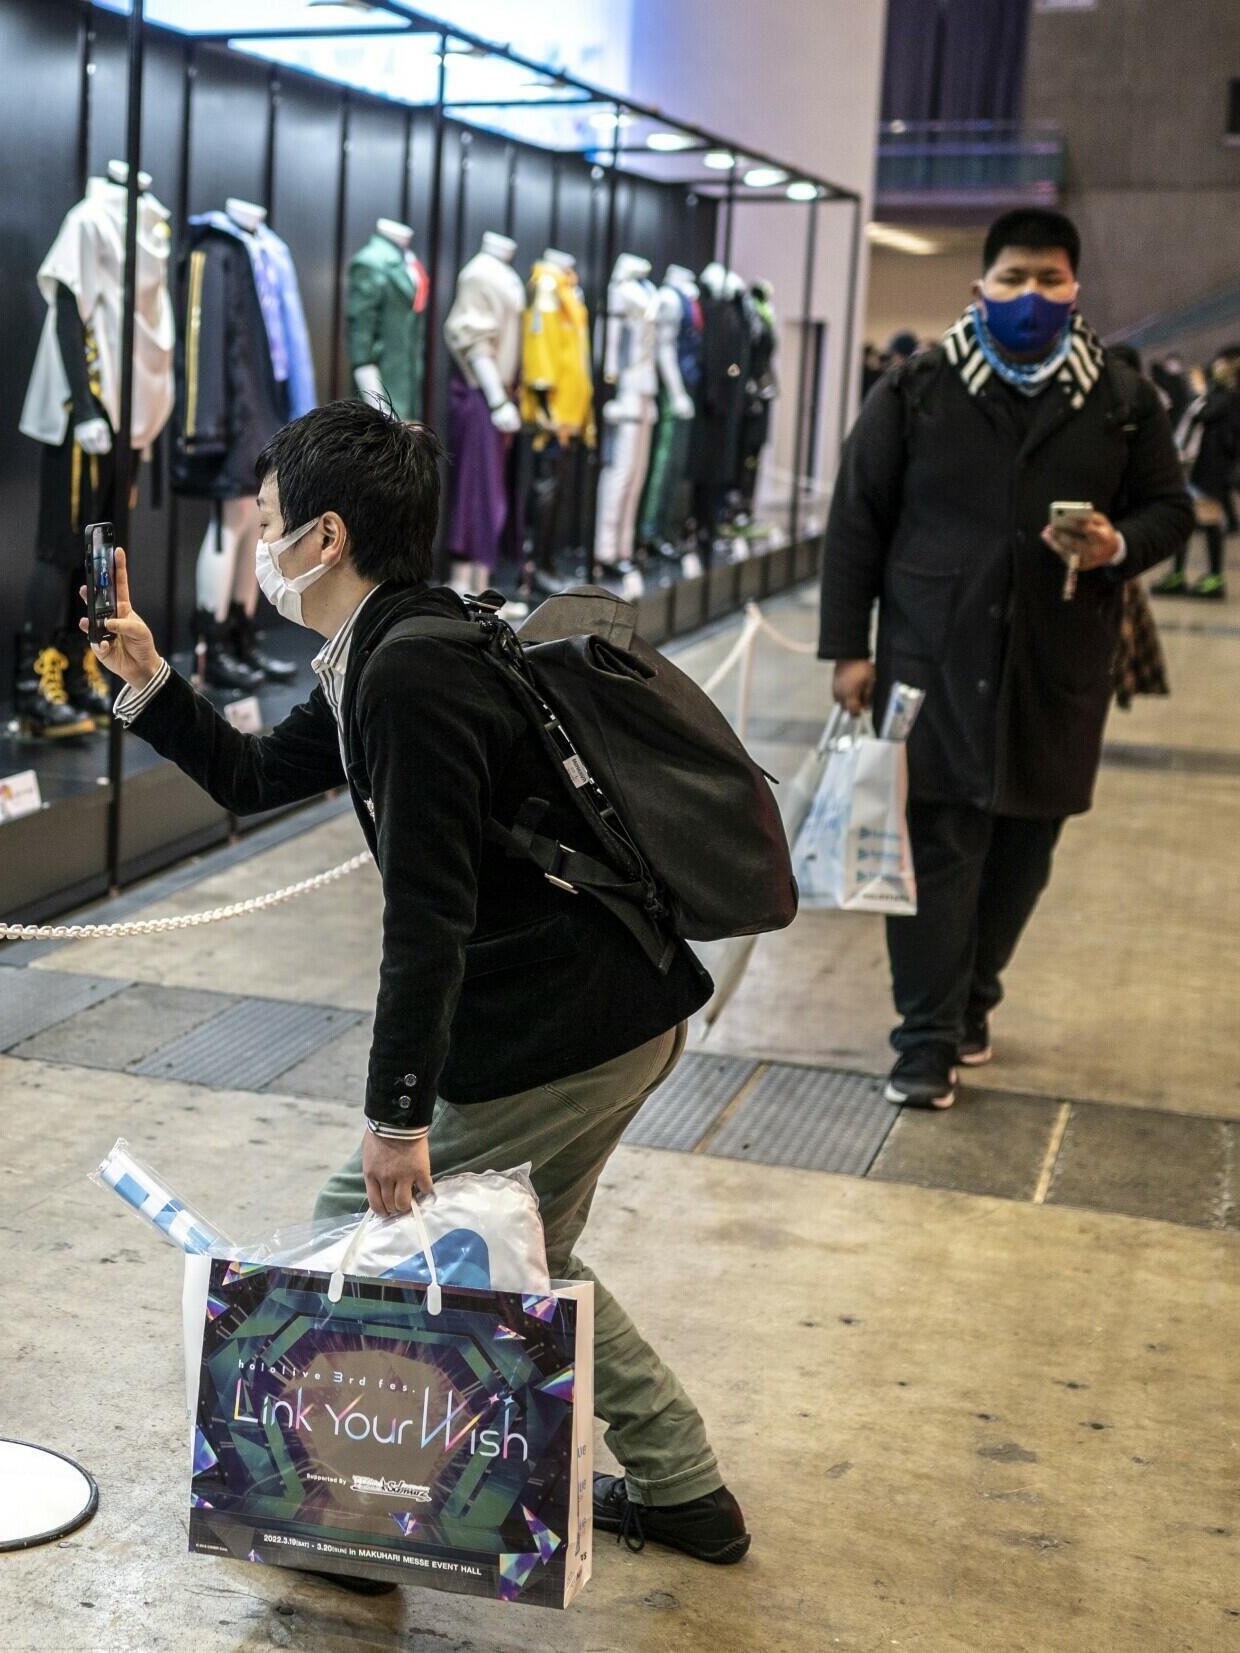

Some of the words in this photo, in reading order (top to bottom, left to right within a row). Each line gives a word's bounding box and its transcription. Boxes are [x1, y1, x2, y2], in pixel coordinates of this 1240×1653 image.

[237, 1359, 322, 1381] hololive
[333, 1370, 366, 1387] 3rd
[377, 1378, 417, 1394] fes.
[233, 1377, 315, 1433] Link
[324, 1393, 415, 1446] Your
[420, 1385, 529, 1462] Wish
[348, 1547, 357, 1557] in
[358, 1548, 401, 1563] MAKUHARI
[402, 1555, 430, 1568] MESSE
[431, 1560, 459, 1572] EVENT
[460, 1563, 483, 1576] HALL
